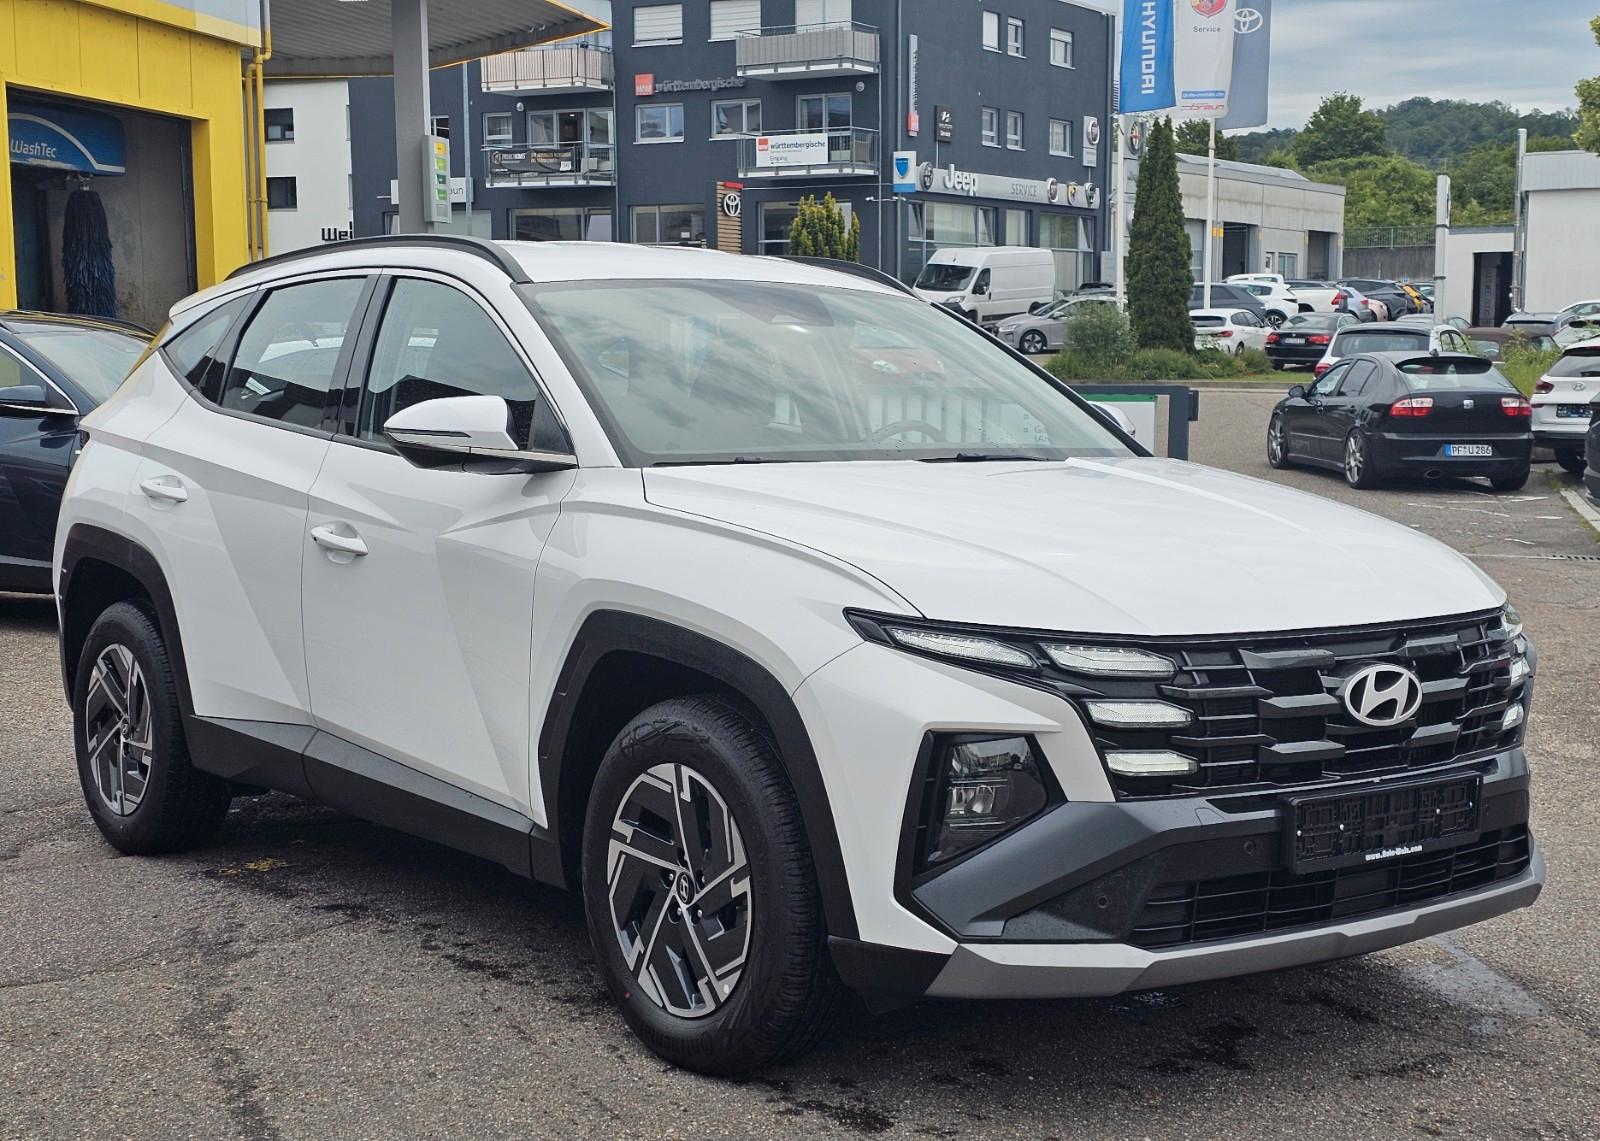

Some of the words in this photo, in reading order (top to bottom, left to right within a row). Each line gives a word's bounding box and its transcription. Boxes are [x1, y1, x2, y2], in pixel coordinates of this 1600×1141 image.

[1193, 25, 1222, 33] Service
[1141, 2, 1156, 95] HYUNDAI
[10, 139, 57, 158] WashTec
[770, 140, 826, 150] württembergische
[943, 163, 979, 197] Jeep
[1011, 183, 1038, 198] SERVICE
[1475, 446, 1491, 455] 286
